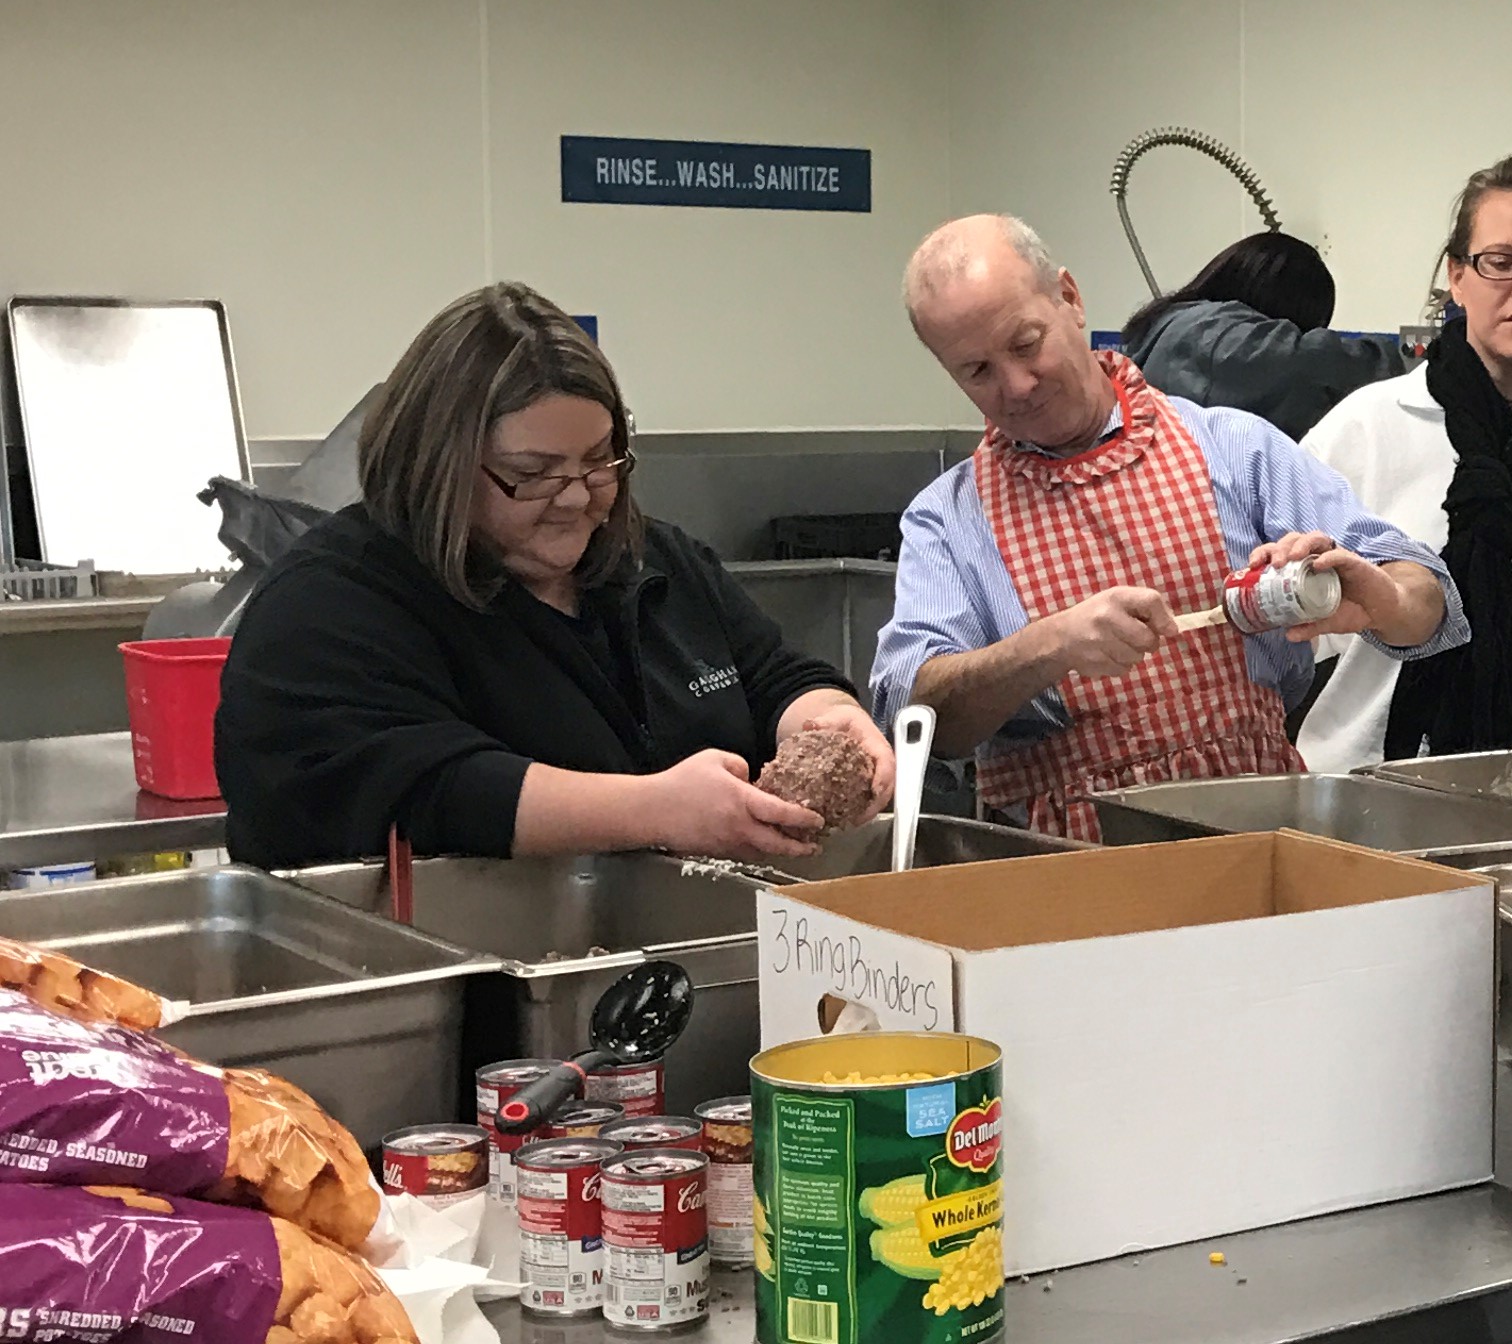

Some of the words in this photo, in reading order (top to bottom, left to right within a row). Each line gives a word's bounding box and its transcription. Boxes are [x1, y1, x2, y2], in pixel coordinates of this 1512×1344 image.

[772, 909, 791, 974] 3
[797, 917, 846, 992] Ring
[849, 935, 939, 1031] Binders
[815, 1109, 841, 1120] Packed
[915, 1114, 950, 1130] SALT
[918, 1107, 946, 1120] SEA
[954, 1126, 977, 1152] Del
[65, 1141, 148, 1170] SEASONED
[932, 1207, 975, 1230] Whole
[37, 1307, 124, 1333] SHREDDED,
[131, 1311, 197, 1336] SASONED
[33, 1328, 113, 1344] POTTOES
